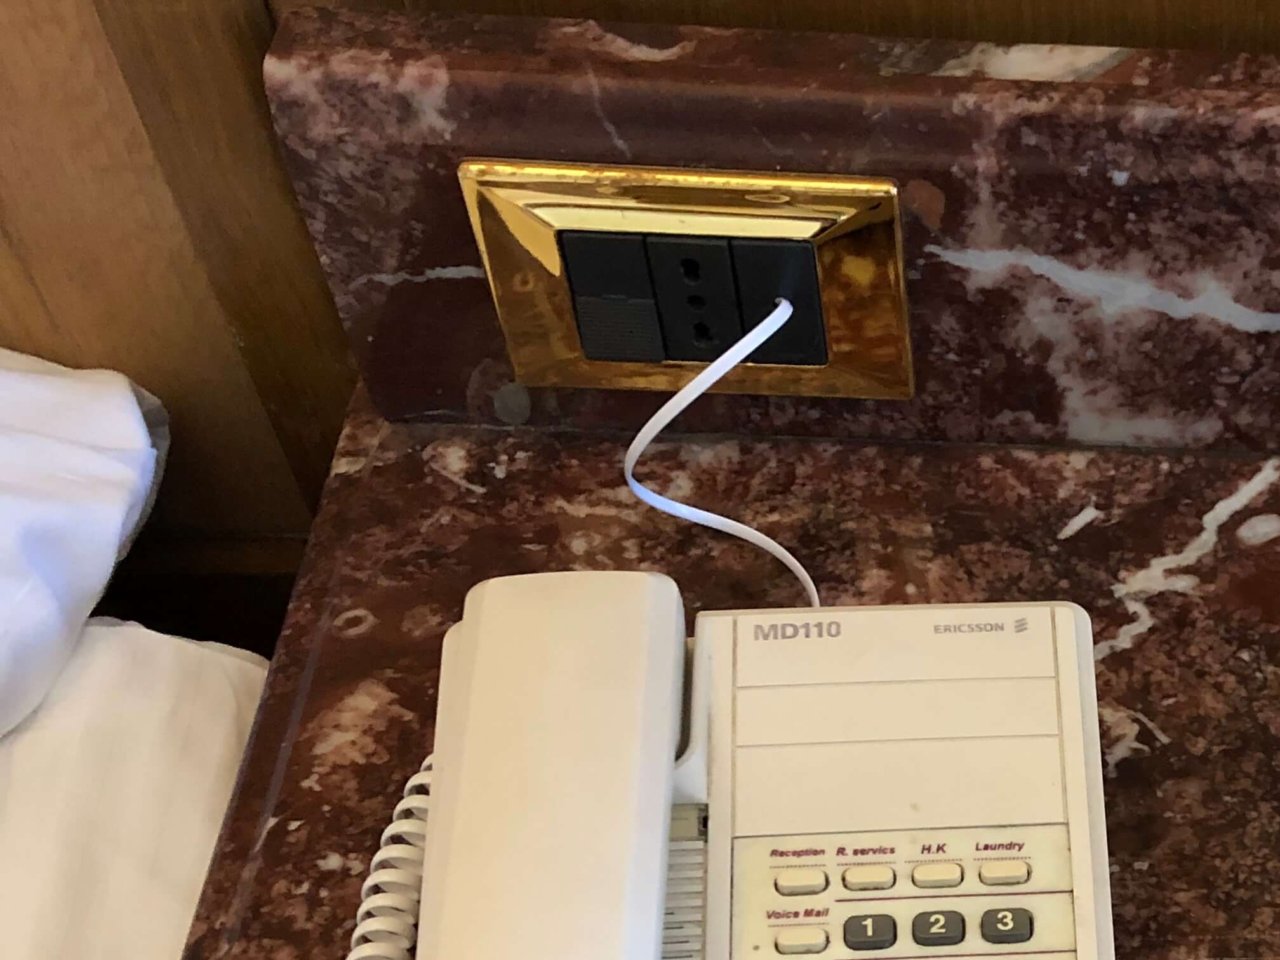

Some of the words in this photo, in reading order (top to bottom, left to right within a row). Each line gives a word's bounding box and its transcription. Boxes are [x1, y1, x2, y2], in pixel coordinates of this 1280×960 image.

[753, 621, 842, 641] MD110
[933, 623, 1005, 634] ERICSSON
[921, 843, 946, 855] H.K
[975, 841, 1025, 852] Laundry
[770, 848, 826, 858] Reception
[766, 910, 800, 919] Voice
[803, 907, 830, 917] Mail
[929, 914, 946, 934] 2
[996, 911, 1014, 930] 3
[861, 918, 873, 936] 1
